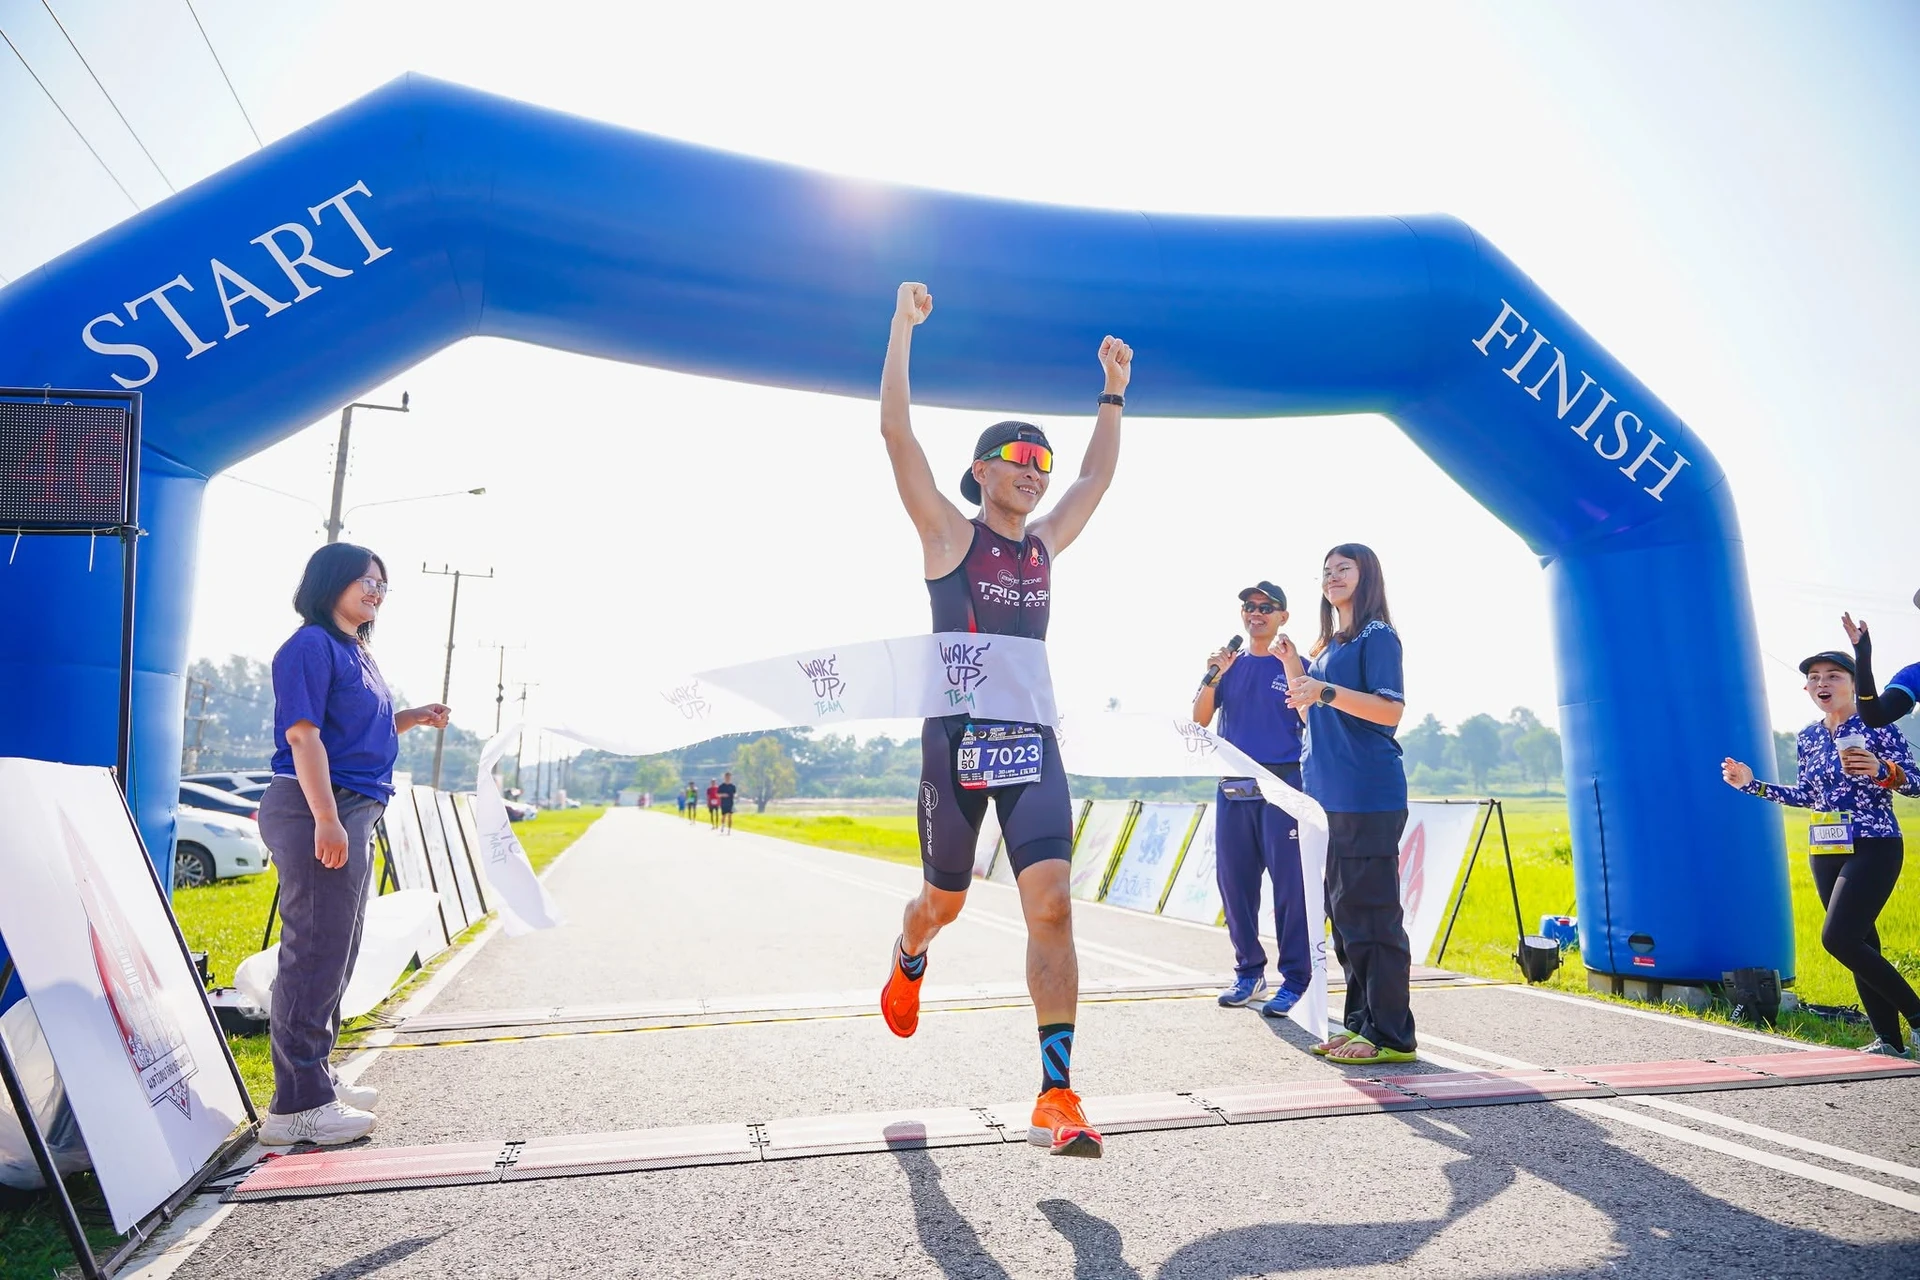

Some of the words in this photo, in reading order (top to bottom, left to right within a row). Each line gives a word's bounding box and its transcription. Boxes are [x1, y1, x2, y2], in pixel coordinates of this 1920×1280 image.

[82, 179, 393, 389] START
[1471, 298, 1692, 502] FINISH
[978, 581, 1050, 602] TRIDASH
[1022, 577, 1042, 585] ZONE
[797, 654, 839, 679] WAKE
[939, 642, 991, 667] WAKE
[812, 677, 846, 701] UP!
[946, 665, 988, 692] UP!
[814, 700, 844, 717] TEAM
[944, 688, 976, 709] TEM
[986, 744, 1040, 766] 7023
[924, 787, 932, 819] BIKE
